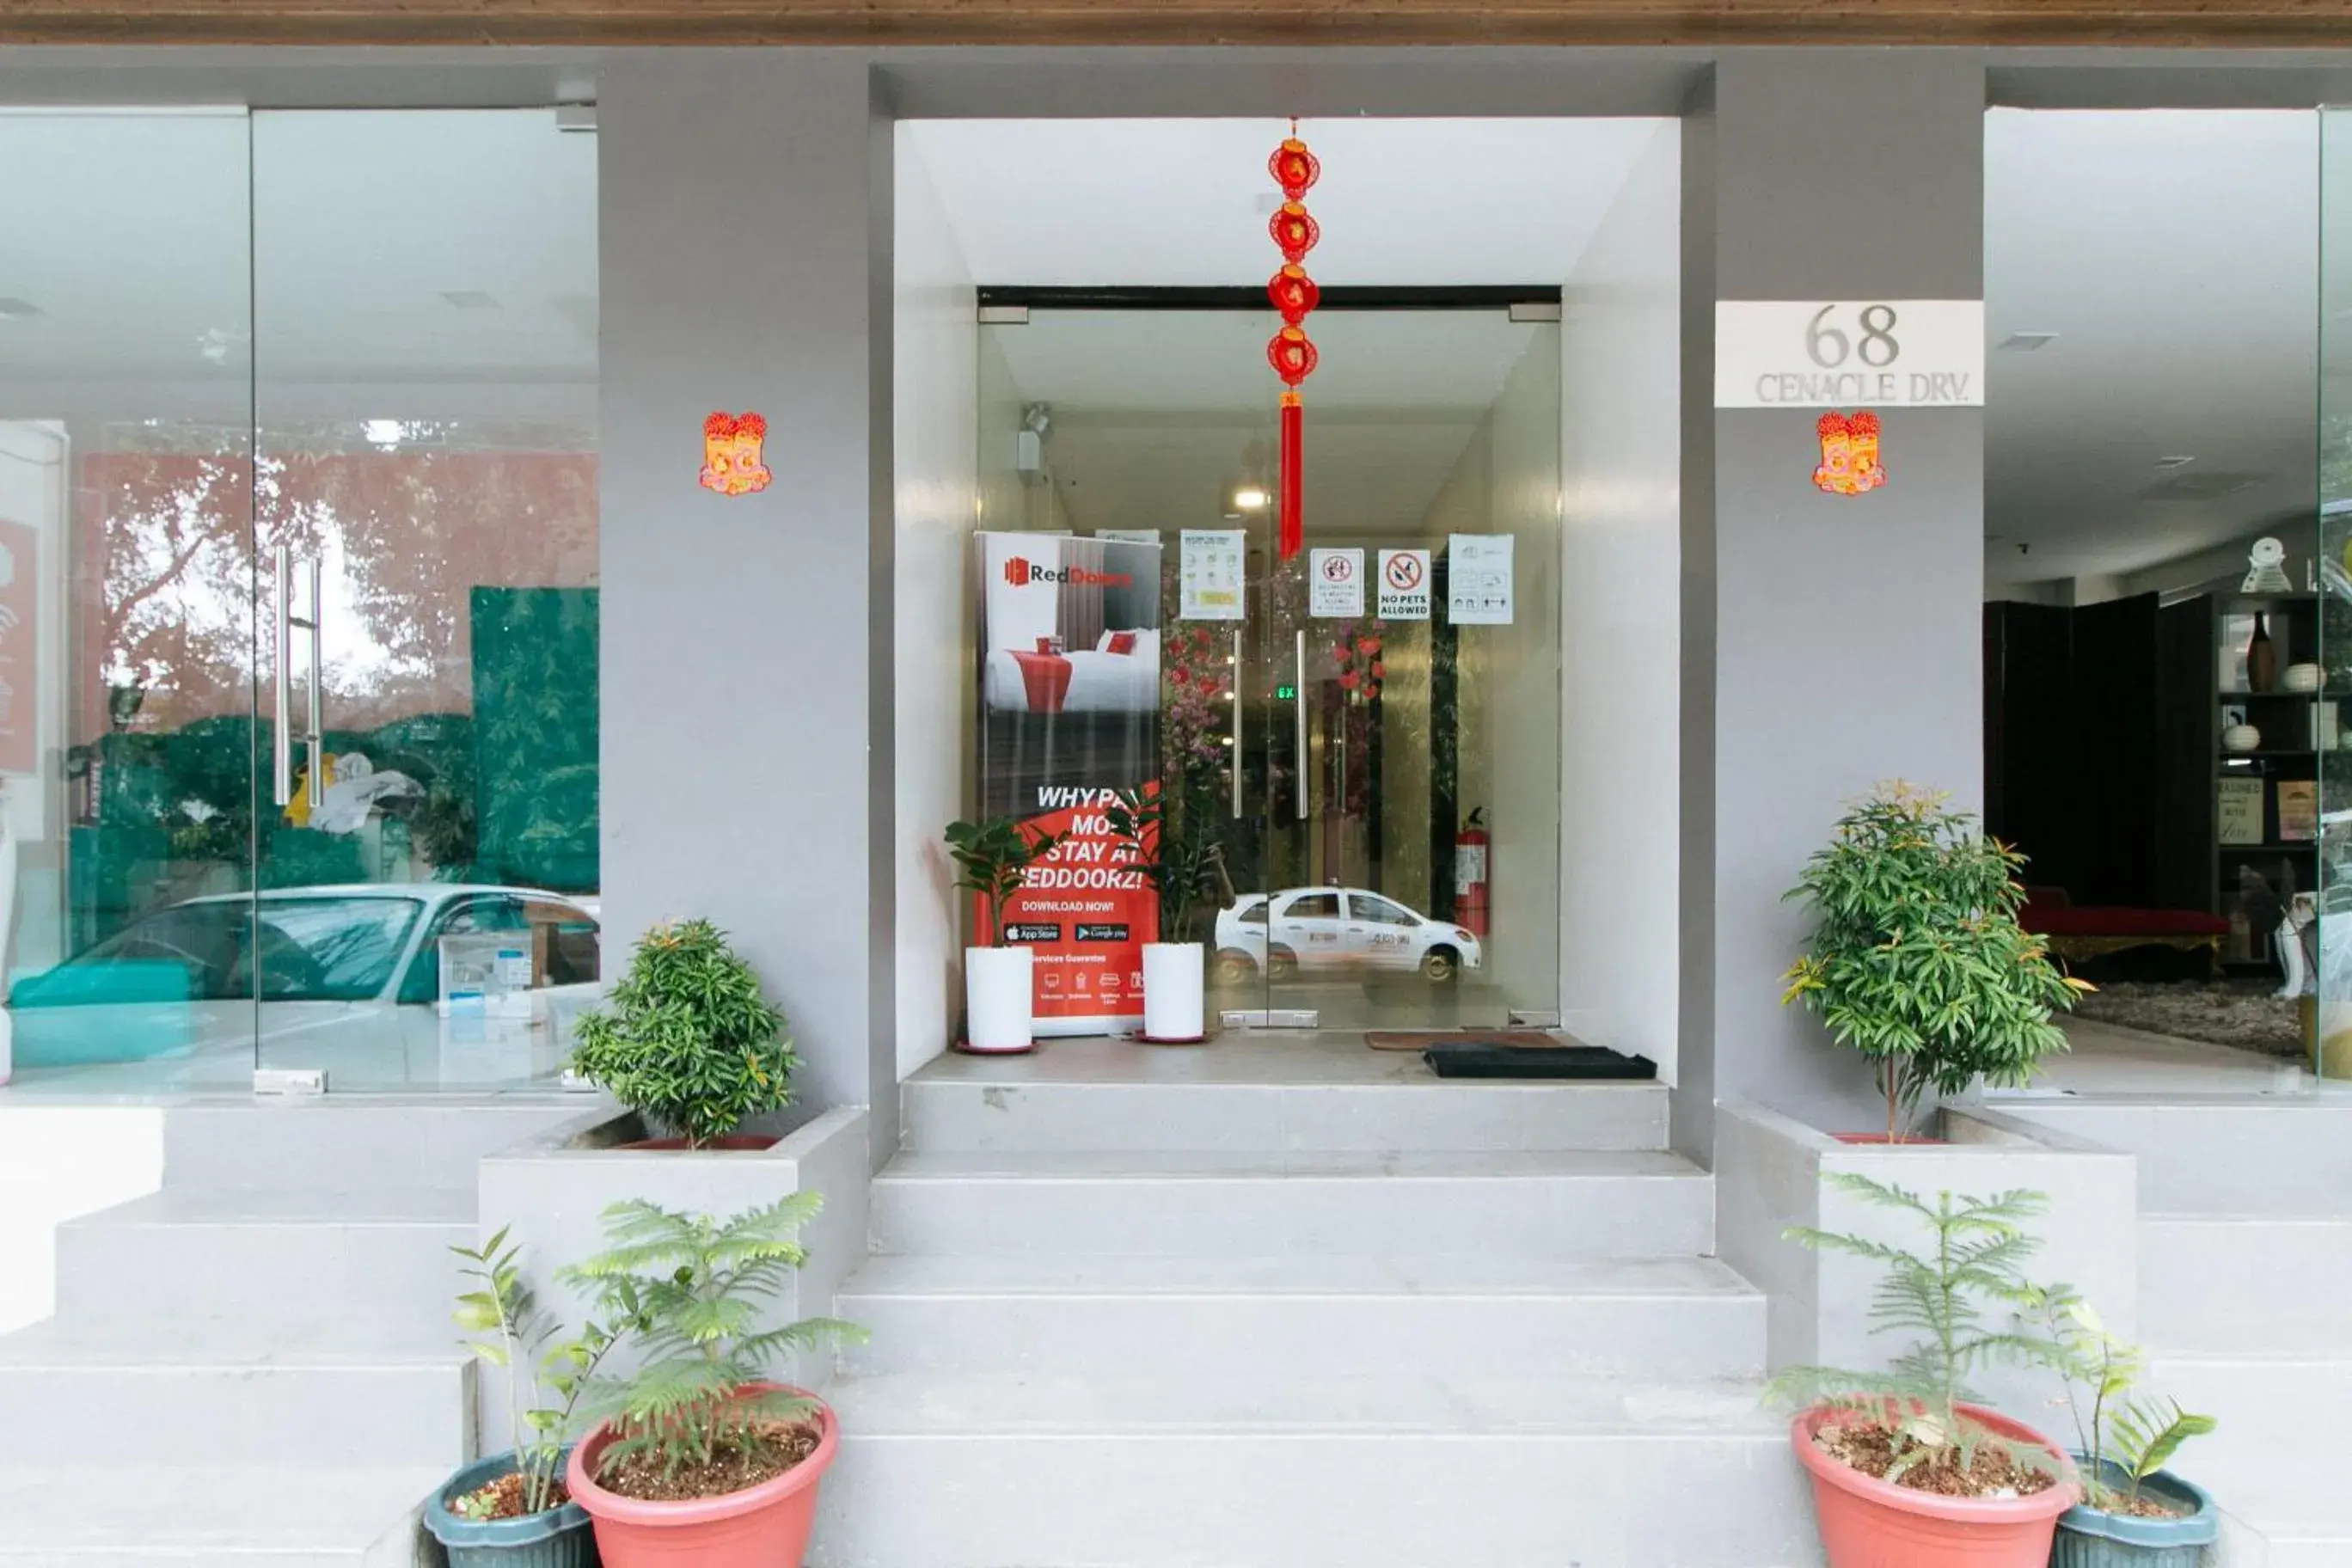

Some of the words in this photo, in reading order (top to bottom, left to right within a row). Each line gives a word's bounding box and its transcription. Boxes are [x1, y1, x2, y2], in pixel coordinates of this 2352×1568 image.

[1806, 304, 1899, 369] 68
[1755, 373, 1896, 402] CENACLE
[1381, 595, 1398, 603] NO
[1401, 595, 1427, 603] PETS
[1381, 606, 1427, 615] ALLOWED
[1038, 787, 1097, 808] WHY
[1045, 839, 1107, 863] STAY
[1111, 842, 1139, 863] AT
[1021, 901, 1084, 912] DOWNLOAD
[1086, 902, 1115, 912] NOW!
[1020, 929, 1037, 940] App
[1038, 929, 1058, 939] Store
